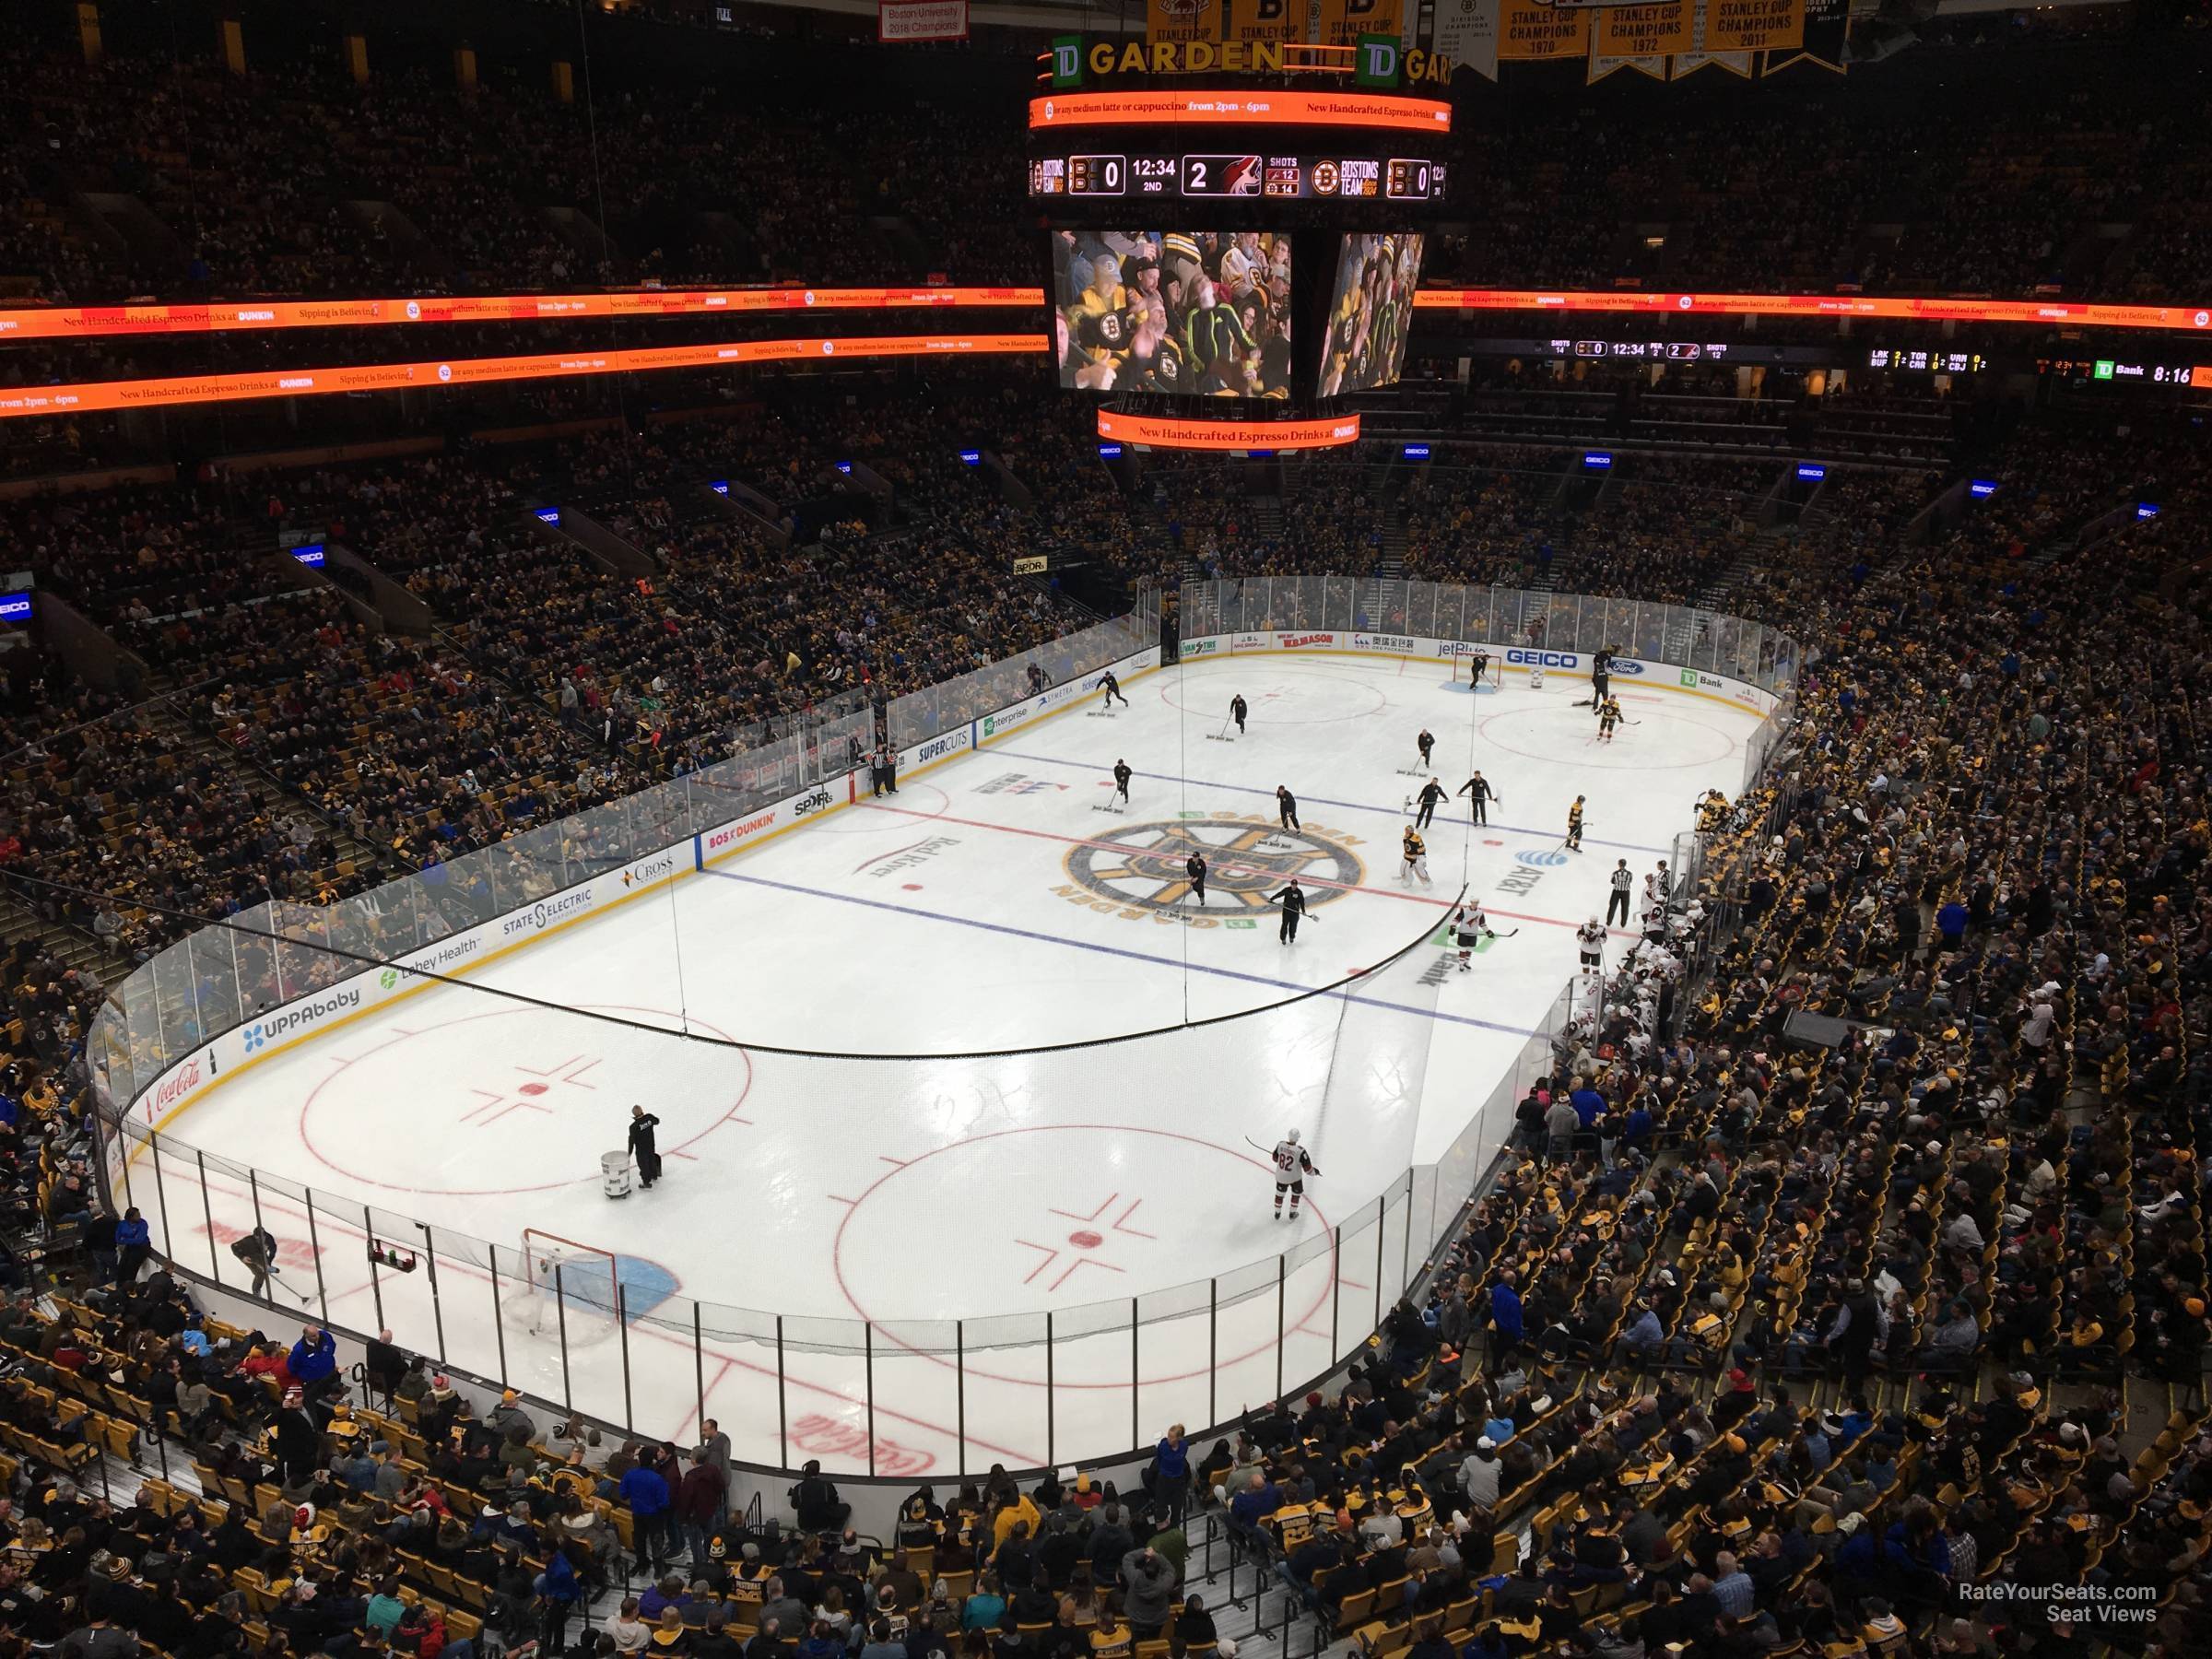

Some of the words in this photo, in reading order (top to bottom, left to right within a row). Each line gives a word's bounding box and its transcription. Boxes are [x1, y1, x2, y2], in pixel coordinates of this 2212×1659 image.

[888, 8, 915, 19] Boston
[918, 6, 959, 19] University
[1613, 7, 1660, 21] STANLEY
[1662, 6, 1681, 19] CUP
[1719, 2, 1768, 16] STANLEY
[1771, 0, 1793, 14] CUP
[1511, 11, 1557, 25] STANLEY
[1559, 9, 1577, 22] CUP
[1717, 16, 1791, 31] CHAMPIONS
[889, 23, 909, 34] 2018
[911, 20, 958, 33] Champions
[1241, 27, 1278, 38] STANLEY
[1280, 26, 1299, 38] CUP
[1332, 21, 1371, 33] STANLEY
[1372, 19, 1393, 31] CUP
[1445, 22, 1488, 30] CHAMPIONS
[1510, 24, 1577, 40] CHAMPIONS
[1611, 21, 1682, 37] CHAMPIONS
[1157, 29, 1194, 41] STANLEY
[1195, 29, 1211, 40] CUP
[1740, 34, 1766, 46] 2011
[1529, 41, 1555, 53] 1970
[1632, 39, 1658, 53] 1972
[1055, 45, 1079, 76] TD
[1088, 41, 1284, 75] GARDEN
[1363, 43, 1395, 76] TD
[1062, 106, 1071, 115] any
[1072, 103, 1102, 113] medium
[1103, 101, 1121, 112] latte
[1133, 101, 1187, 115] cappuccino
[1188, 100, 1214, 110] from
[1216, 101, 1239, 112] 2pm
[1246, 101, 1270, 112] 6pm
[1307, 103, 1328, 112] New
[1329, 103, 1382, 114] Handcrafted
[1383, 106, 1412, 118] Espresso
[1413, 109, 1431, 119] Drinks
[1133, 159, 1176, 176] 12:34
[1270, 157, 1298, 167] SHOTS
[1105, 161, 1119, 187] 0
[1190, 162, 1206, 188] 2
[1282, 170, 1293, 179] 12
[1418, 167, 1427, 192] 0
[1143, 182, 1162, 191] 2ND
[1280, 184, 1292, 194] 14
[1341, 178, 1363, 196] TEAM
[299, 309, 332, 320] Sipping
[431, 307, 445, 316] any
[446, 304, 475, 314] medium
[476, 303, 490, 312] latte
[500, 302, 538, 314] cappuccino
[538, 302, 553, 312] from
[64, 317, 88, 328] New
[88, 314, 151, 328] Handcrafted
[152, 312, 194, 326] Espresso
[194, 312, 226, 324] Drinks
[227, 314, 237, 323] at
[1594, 344, 1602, 354] 0
[1612, 344, 1645, 356] 12:34
[1650, 342, 1664, 350] PER.
[1671, 346, 1679, 356] 2
[1706, 344, 1727, 352] SHOTS
[1712, 351, 1721, 359] 12
[1872, 350, 1889, 359] LAK
[1894, 351, 1901, 359] 2
[1911, 351, 1927, 360] TOR
[1949, 353, 1967, 362] VAN
[1973, 355, 1981, 363] 0
[462, 369, 475, 378] any
[475, 365, 501, 376] medium
[502, 364, 517, 373] latte
[525, 361, 560, 374] cappuccino
[1870, 359, 1888, 367] BUF
[1909, 360, 1926, 370] CAR
[1948, 362, 1966, 371] CBJ
[2099, 364, 2112, 376] TD
[2115, 364, 2144, 375] Bank
[339, 373, 370, 385] Sipping
[2153, 366, 2190, 384] 8:16
[120, 390, 140, 400] New
[141, 385, 200, 399] Handcrafted
[201, 382, 238, 397] Espresso
[239, 381, 269, 394] Drinks
[270, 382, 279, 390] at
[24, 395, 48, 408] 2pm
[54, 394, 78, 407] 6pm
[1139, 427, 1159, 438] New
[1161, 429, 1236, 442] Handcrafted
[1238, 431, 1288, 446] Espresso
[1289, 429, 1324, 442] Drinks
[1324, 429, 1333, 440] at
[1585, 456, 1610, 465] GEICO
[1798, 468, 1824, 477] GEICO
[1507, 649, 1578, 669] GEICO
[1611, 659, 1637, 674] Ford
[1683, 672, 1696, 685] TD
[1700, 674, 1723, 689] Bank
[1047, 687, 1074, 702] SYMETRA
[985, 708, 1028, 733] enterprise
[919, 730, 967, 763] SUPERCUTS
[709, 832, 729, 849] BOS
[736, 811, 776, 838] DUNKIN'
[913, 837, 962, 856] Red
[634, 857, 673, 881] CROSS
[869, 853, 929, 878] River
[1495, 865, 1545, 896] AT&T
[504, 916, 534, 935] STATE
[547, 888, 593, 916] ELECTRIC
[547, 902, 593, 924] CORPORATION
[401, 955, 437, 981] Lahey
[439, 938, 477, 966] Health
[1416, 951, 1459, 987] Bank
[264, 989, 360, 1040] UPPAbaby
[1278, 1153, 1294, 1171] 82
